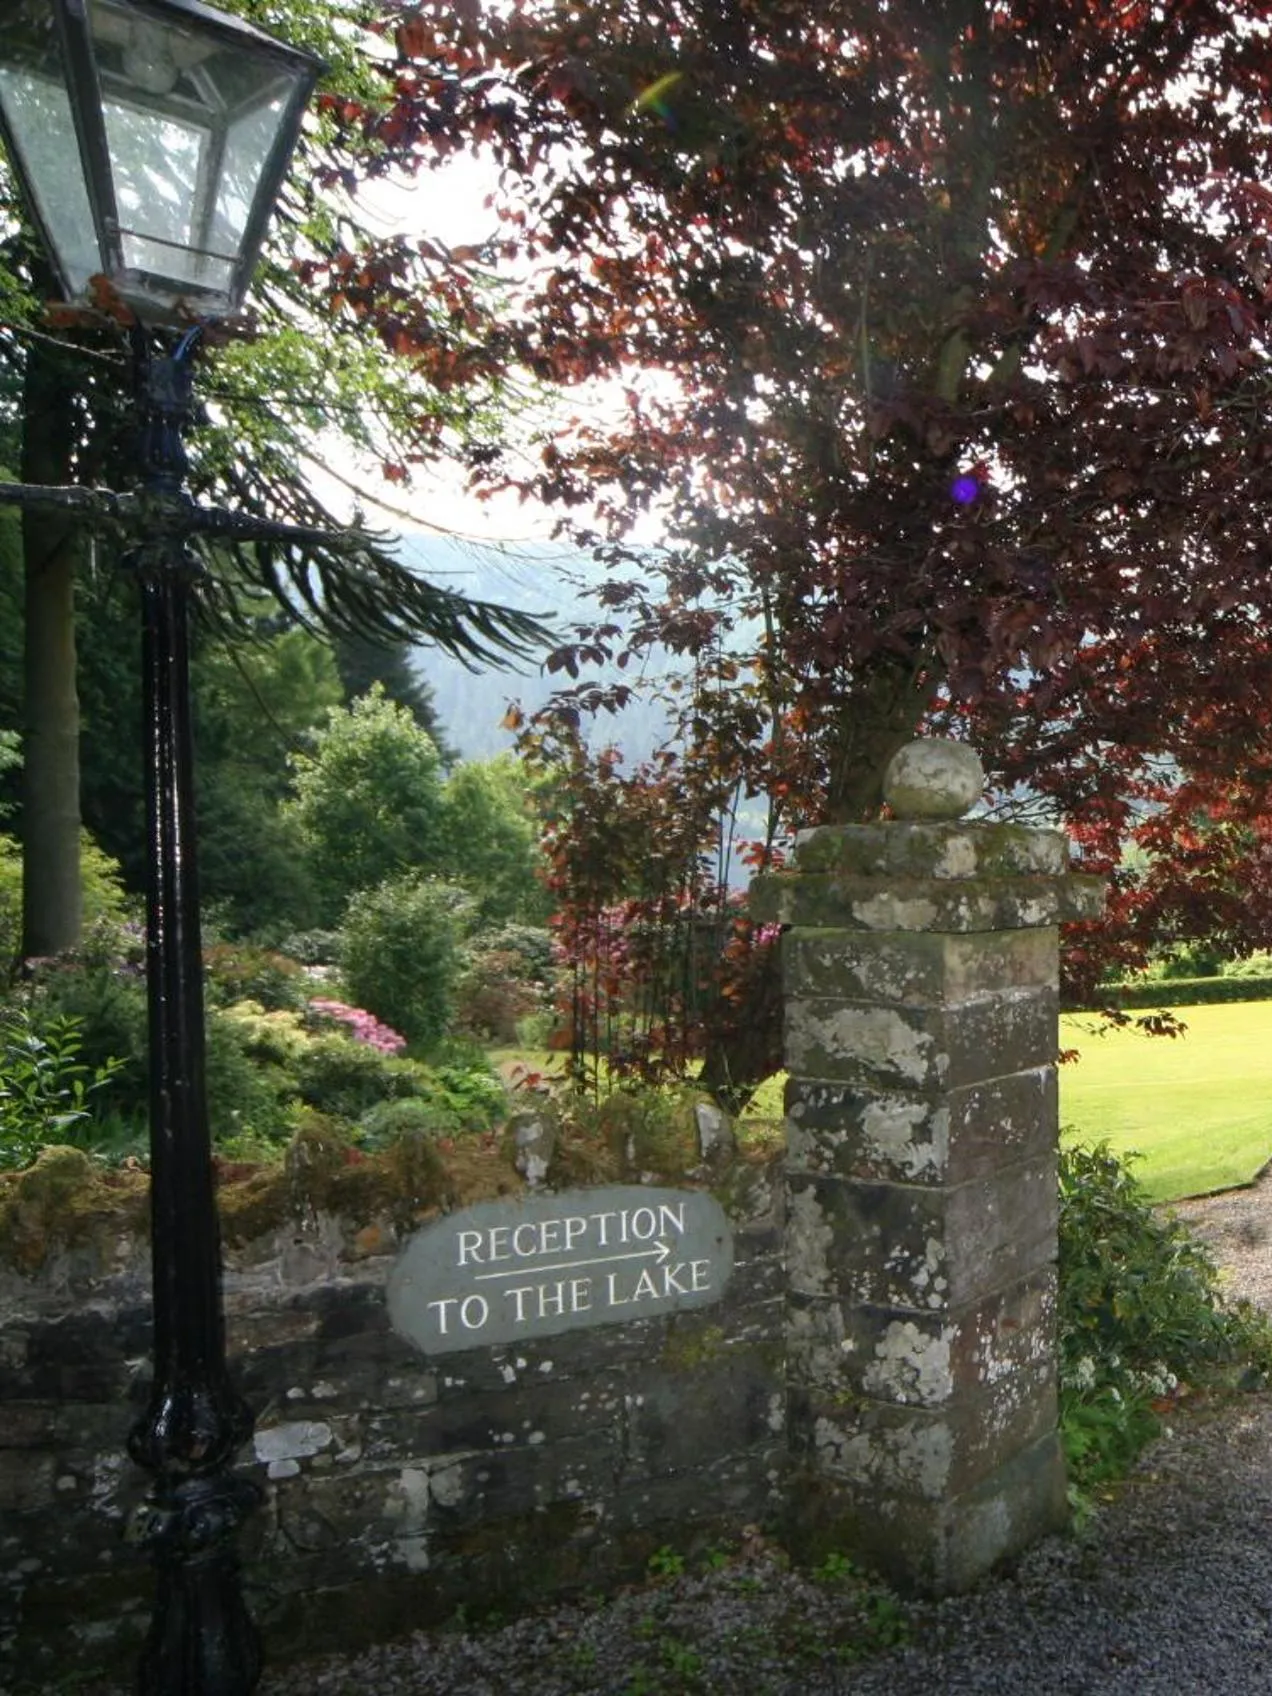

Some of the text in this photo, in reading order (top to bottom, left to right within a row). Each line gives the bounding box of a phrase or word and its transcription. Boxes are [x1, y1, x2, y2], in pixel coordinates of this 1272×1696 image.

[456, 1203, 686, 1266] RECEPTION
[427, 1259, 711, 1335] TO THE LAKE
